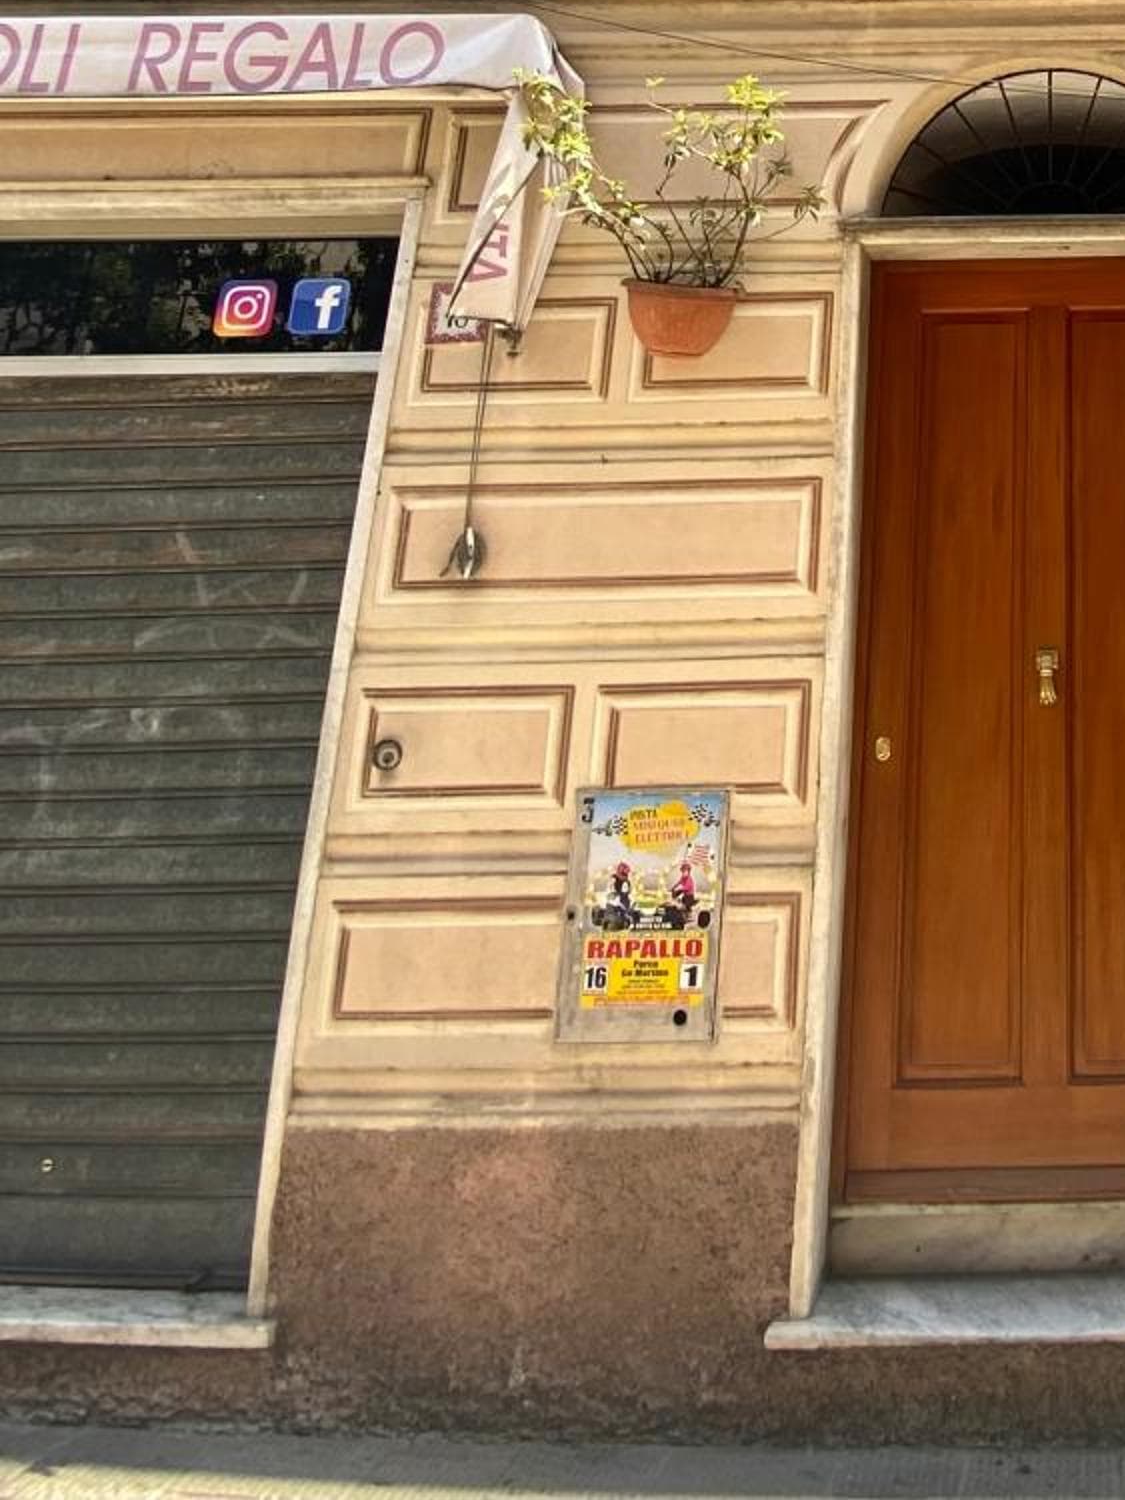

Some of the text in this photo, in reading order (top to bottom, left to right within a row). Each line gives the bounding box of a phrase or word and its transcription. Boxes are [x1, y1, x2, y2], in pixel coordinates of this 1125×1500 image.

[127, 21, 446, 92] REGALO
[587, 938, 704, 959] RAPALLO
[585, 966, 607, 989] 16
[684, 965, 699, 988] 1
